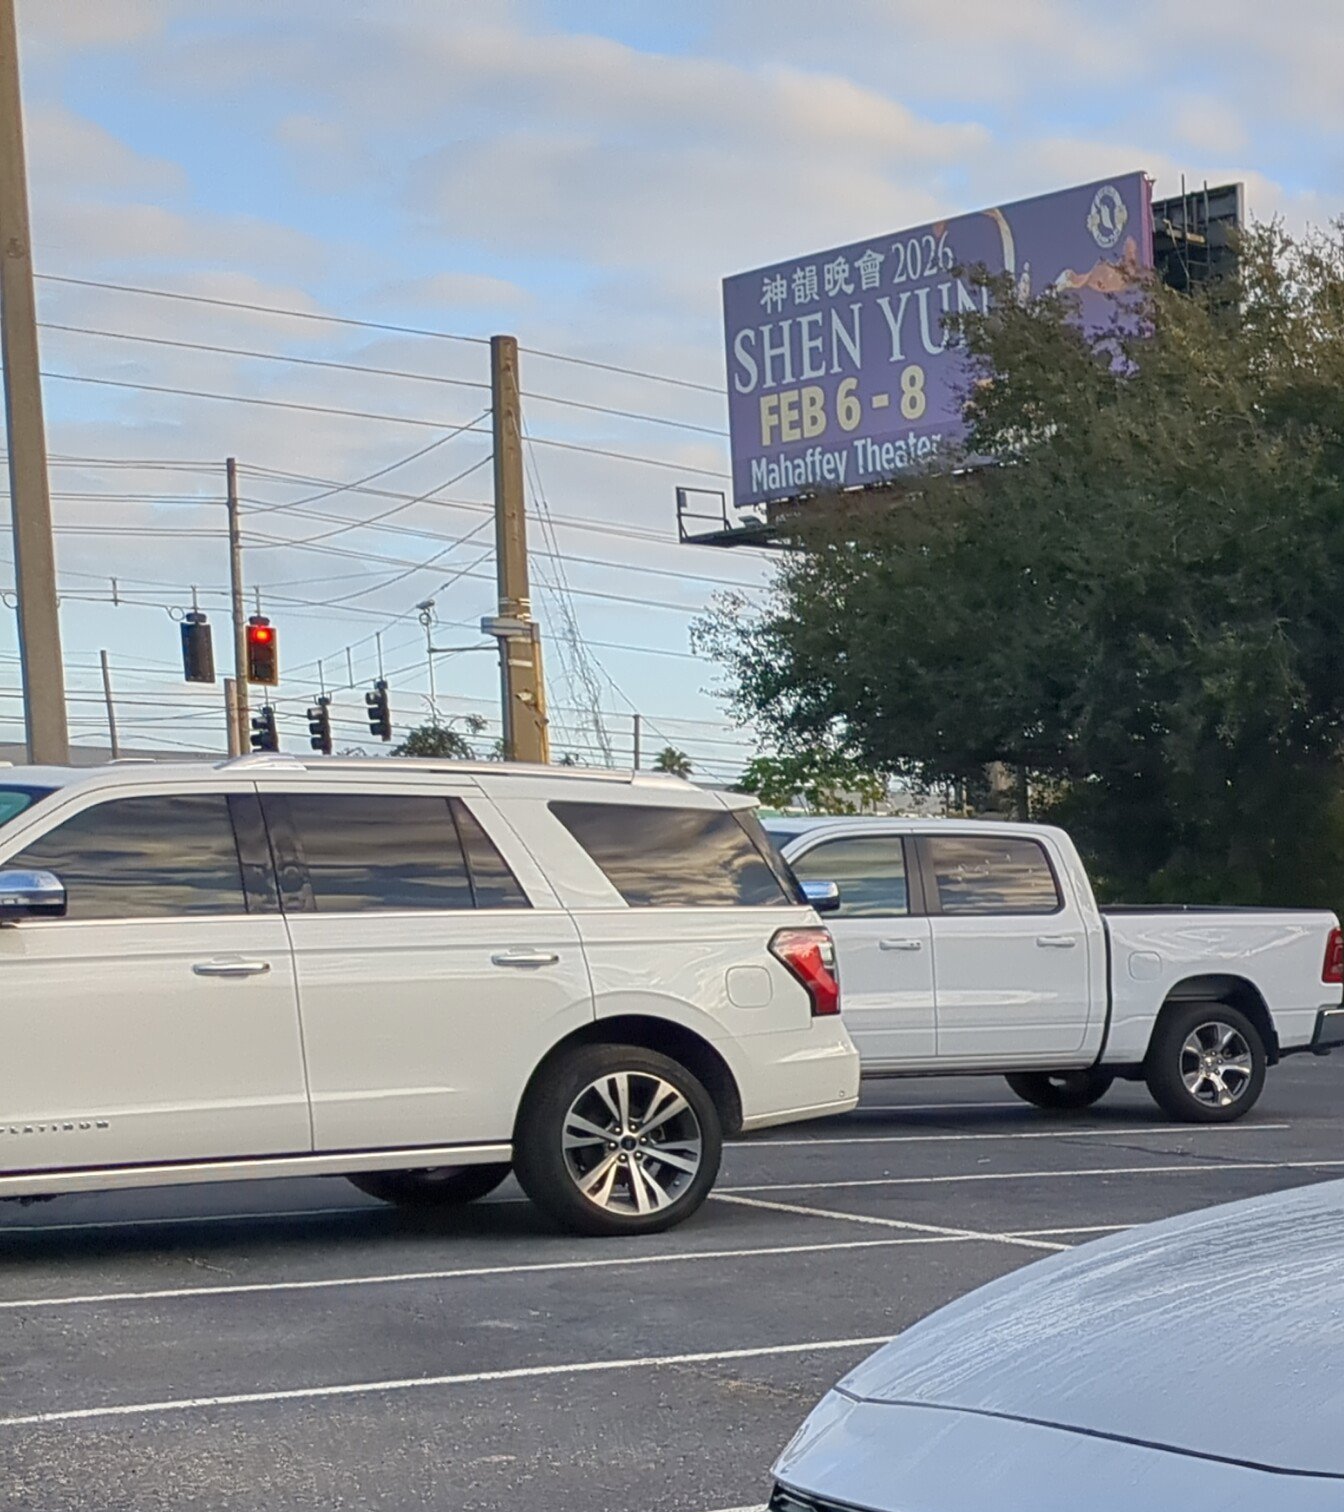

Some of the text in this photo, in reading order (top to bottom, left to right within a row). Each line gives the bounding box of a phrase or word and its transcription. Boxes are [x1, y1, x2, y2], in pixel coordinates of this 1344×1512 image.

[760, 230, 954, 314] 神韻晚會 2026
[733, 302, 863, 394] SHEN
[759, 385, 827, 447] FEB
[836, 377, 861, 432] 6
[900, 364, 926, 420] 8
[751, 446, 848, 493] Mahaffey
[853, 431, 941, 475] Theater
